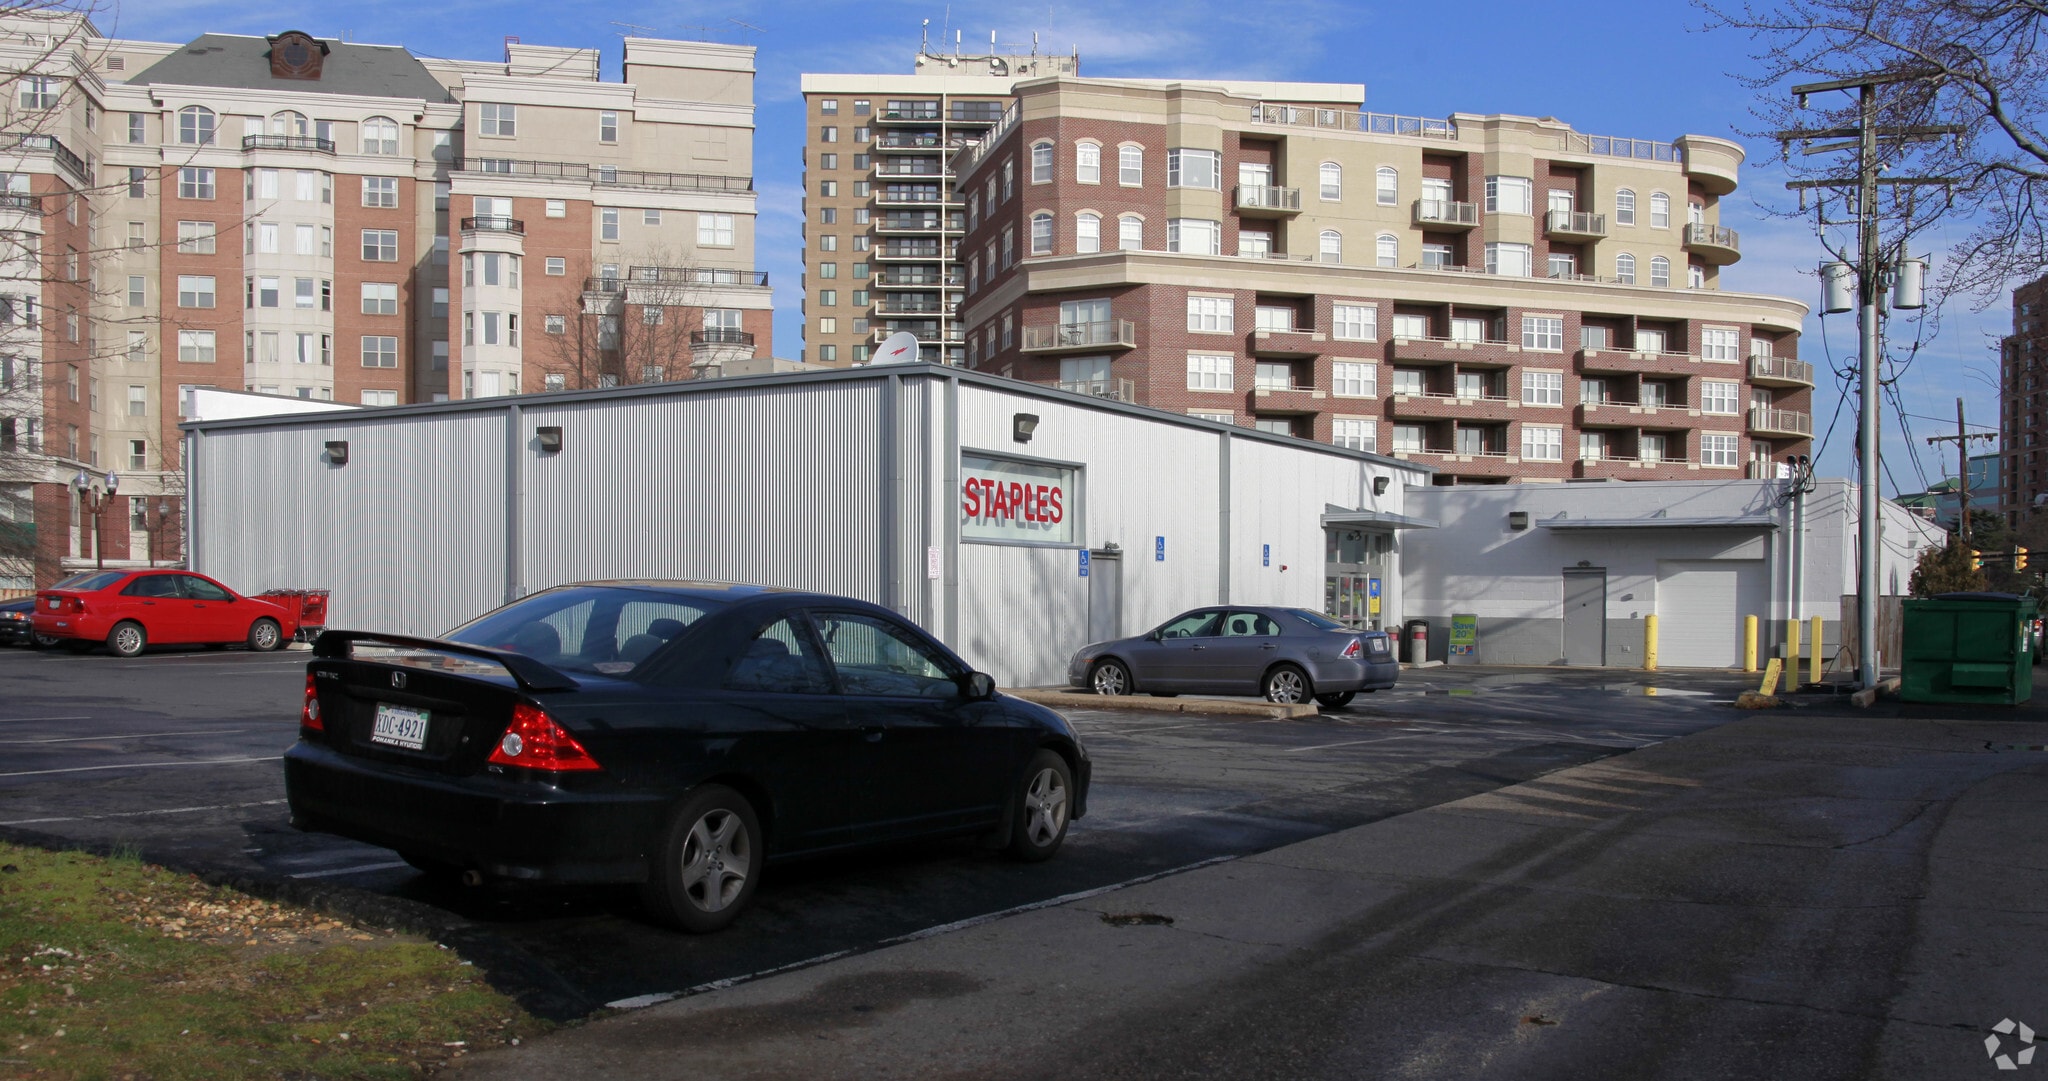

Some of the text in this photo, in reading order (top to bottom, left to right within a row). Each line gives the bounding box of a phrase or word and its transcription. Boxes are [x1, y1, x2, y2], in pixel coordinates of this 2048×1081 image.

[965, 477, 1063, 524] STAPLES
[1453, 622, 1474, 630] Save
[376, 714, 424, 739] XDC-4921
